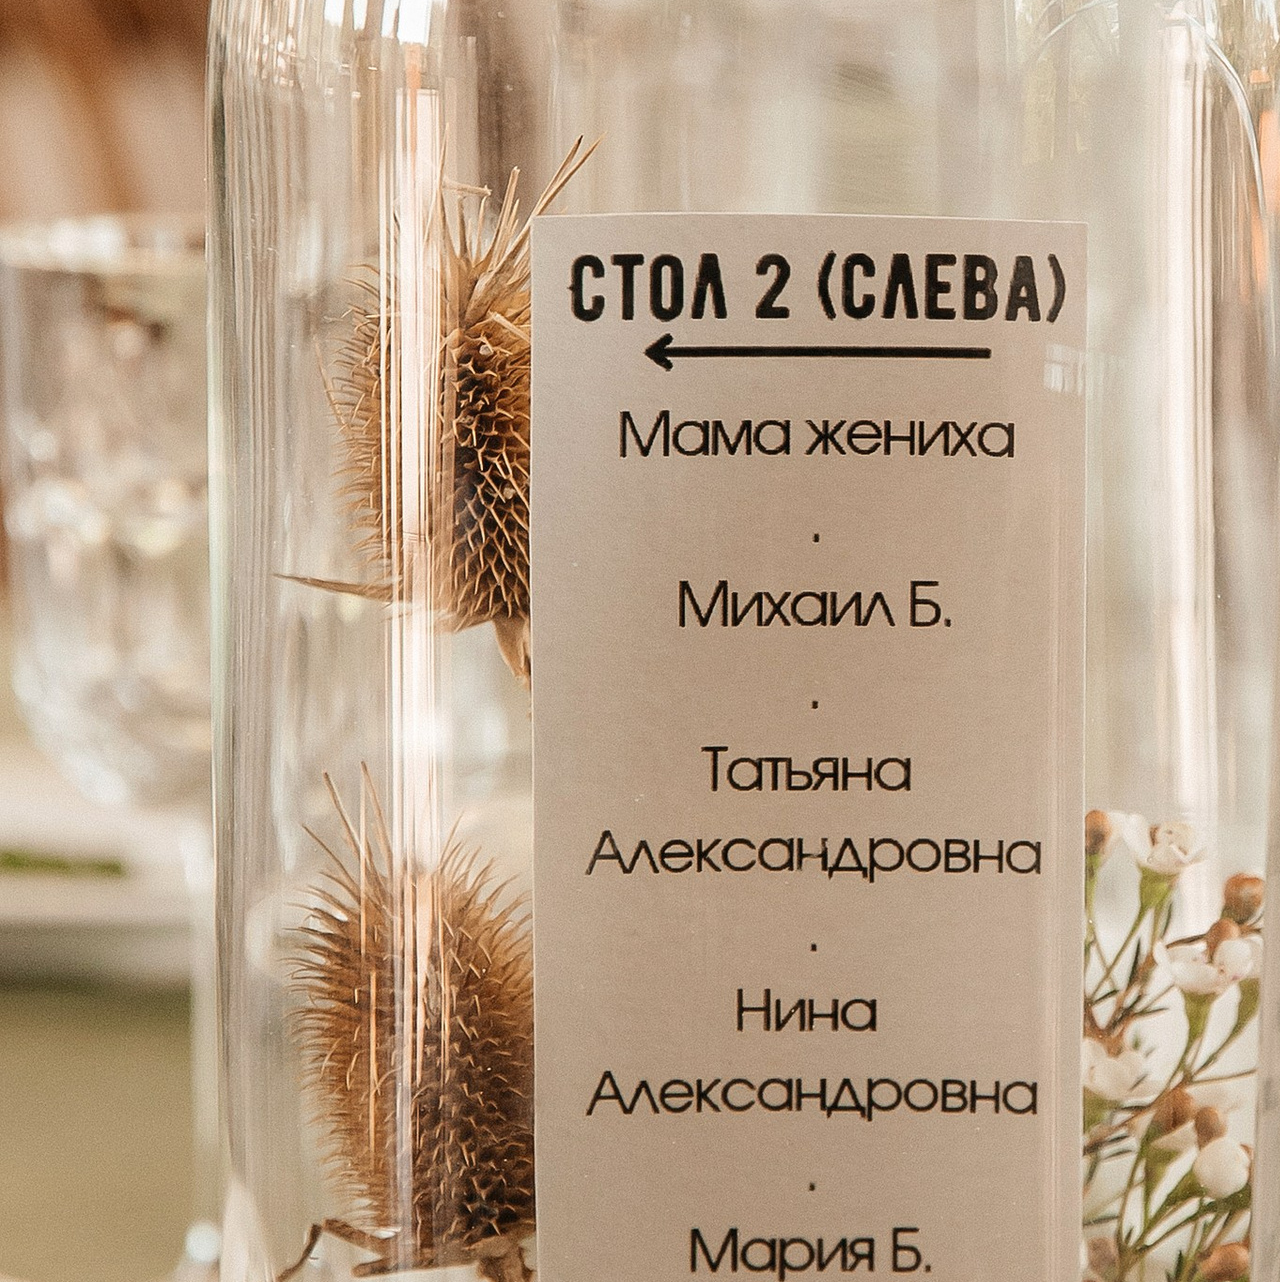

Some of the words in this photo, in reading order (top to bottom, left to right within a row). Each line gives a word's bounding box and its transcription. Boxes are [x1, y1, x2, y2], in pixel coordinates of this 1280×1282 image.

[569, 253, 727, 322] СТОЛ
[756, 254, 790, 318] 2
[818, 251, 1065, 322] (СЛЕВА)
[621, 410, 790, 457] Мама
[806, 420, 1014, 457] жениха
[679, 580, 895, 627] Михаил
[910, 581, 951, 627] Б.
[702, 746, 911, 791] Татьяна
[586, 830, 1041, 883] Александровна
[737, 989, 877, 1031] Нина
[586, 1071, 1037, 1122] Александровна
[690, 1228, 875, 1282] Мария
[892, 1227, 931, 1273] Б.
